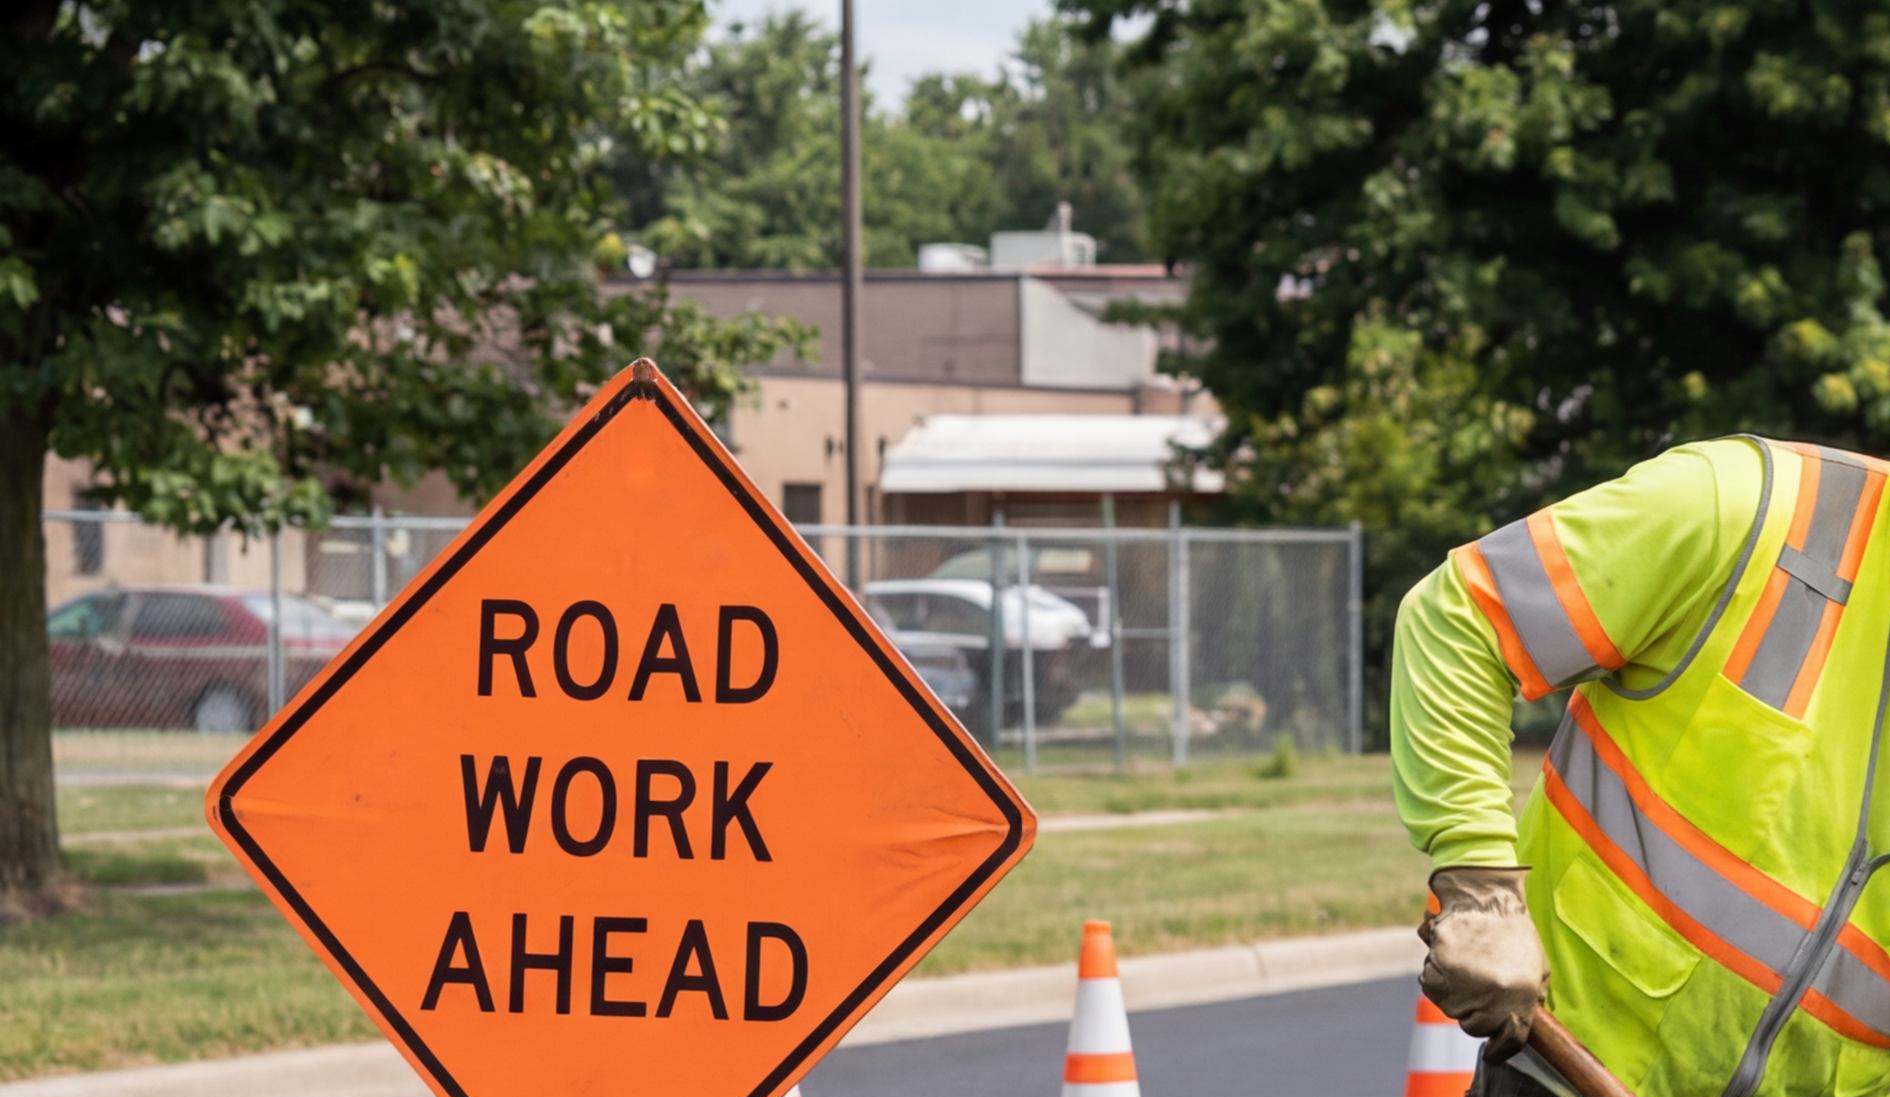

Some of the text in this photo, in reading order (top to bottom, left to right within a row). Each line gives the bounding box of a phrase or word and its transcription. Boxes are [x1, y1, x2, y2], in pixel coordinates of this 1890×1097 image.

[478, 600, 778, 703] ROAD
[461, 755, 772, 861] WORK
[421, 912, 807, 1021] AHEAD
